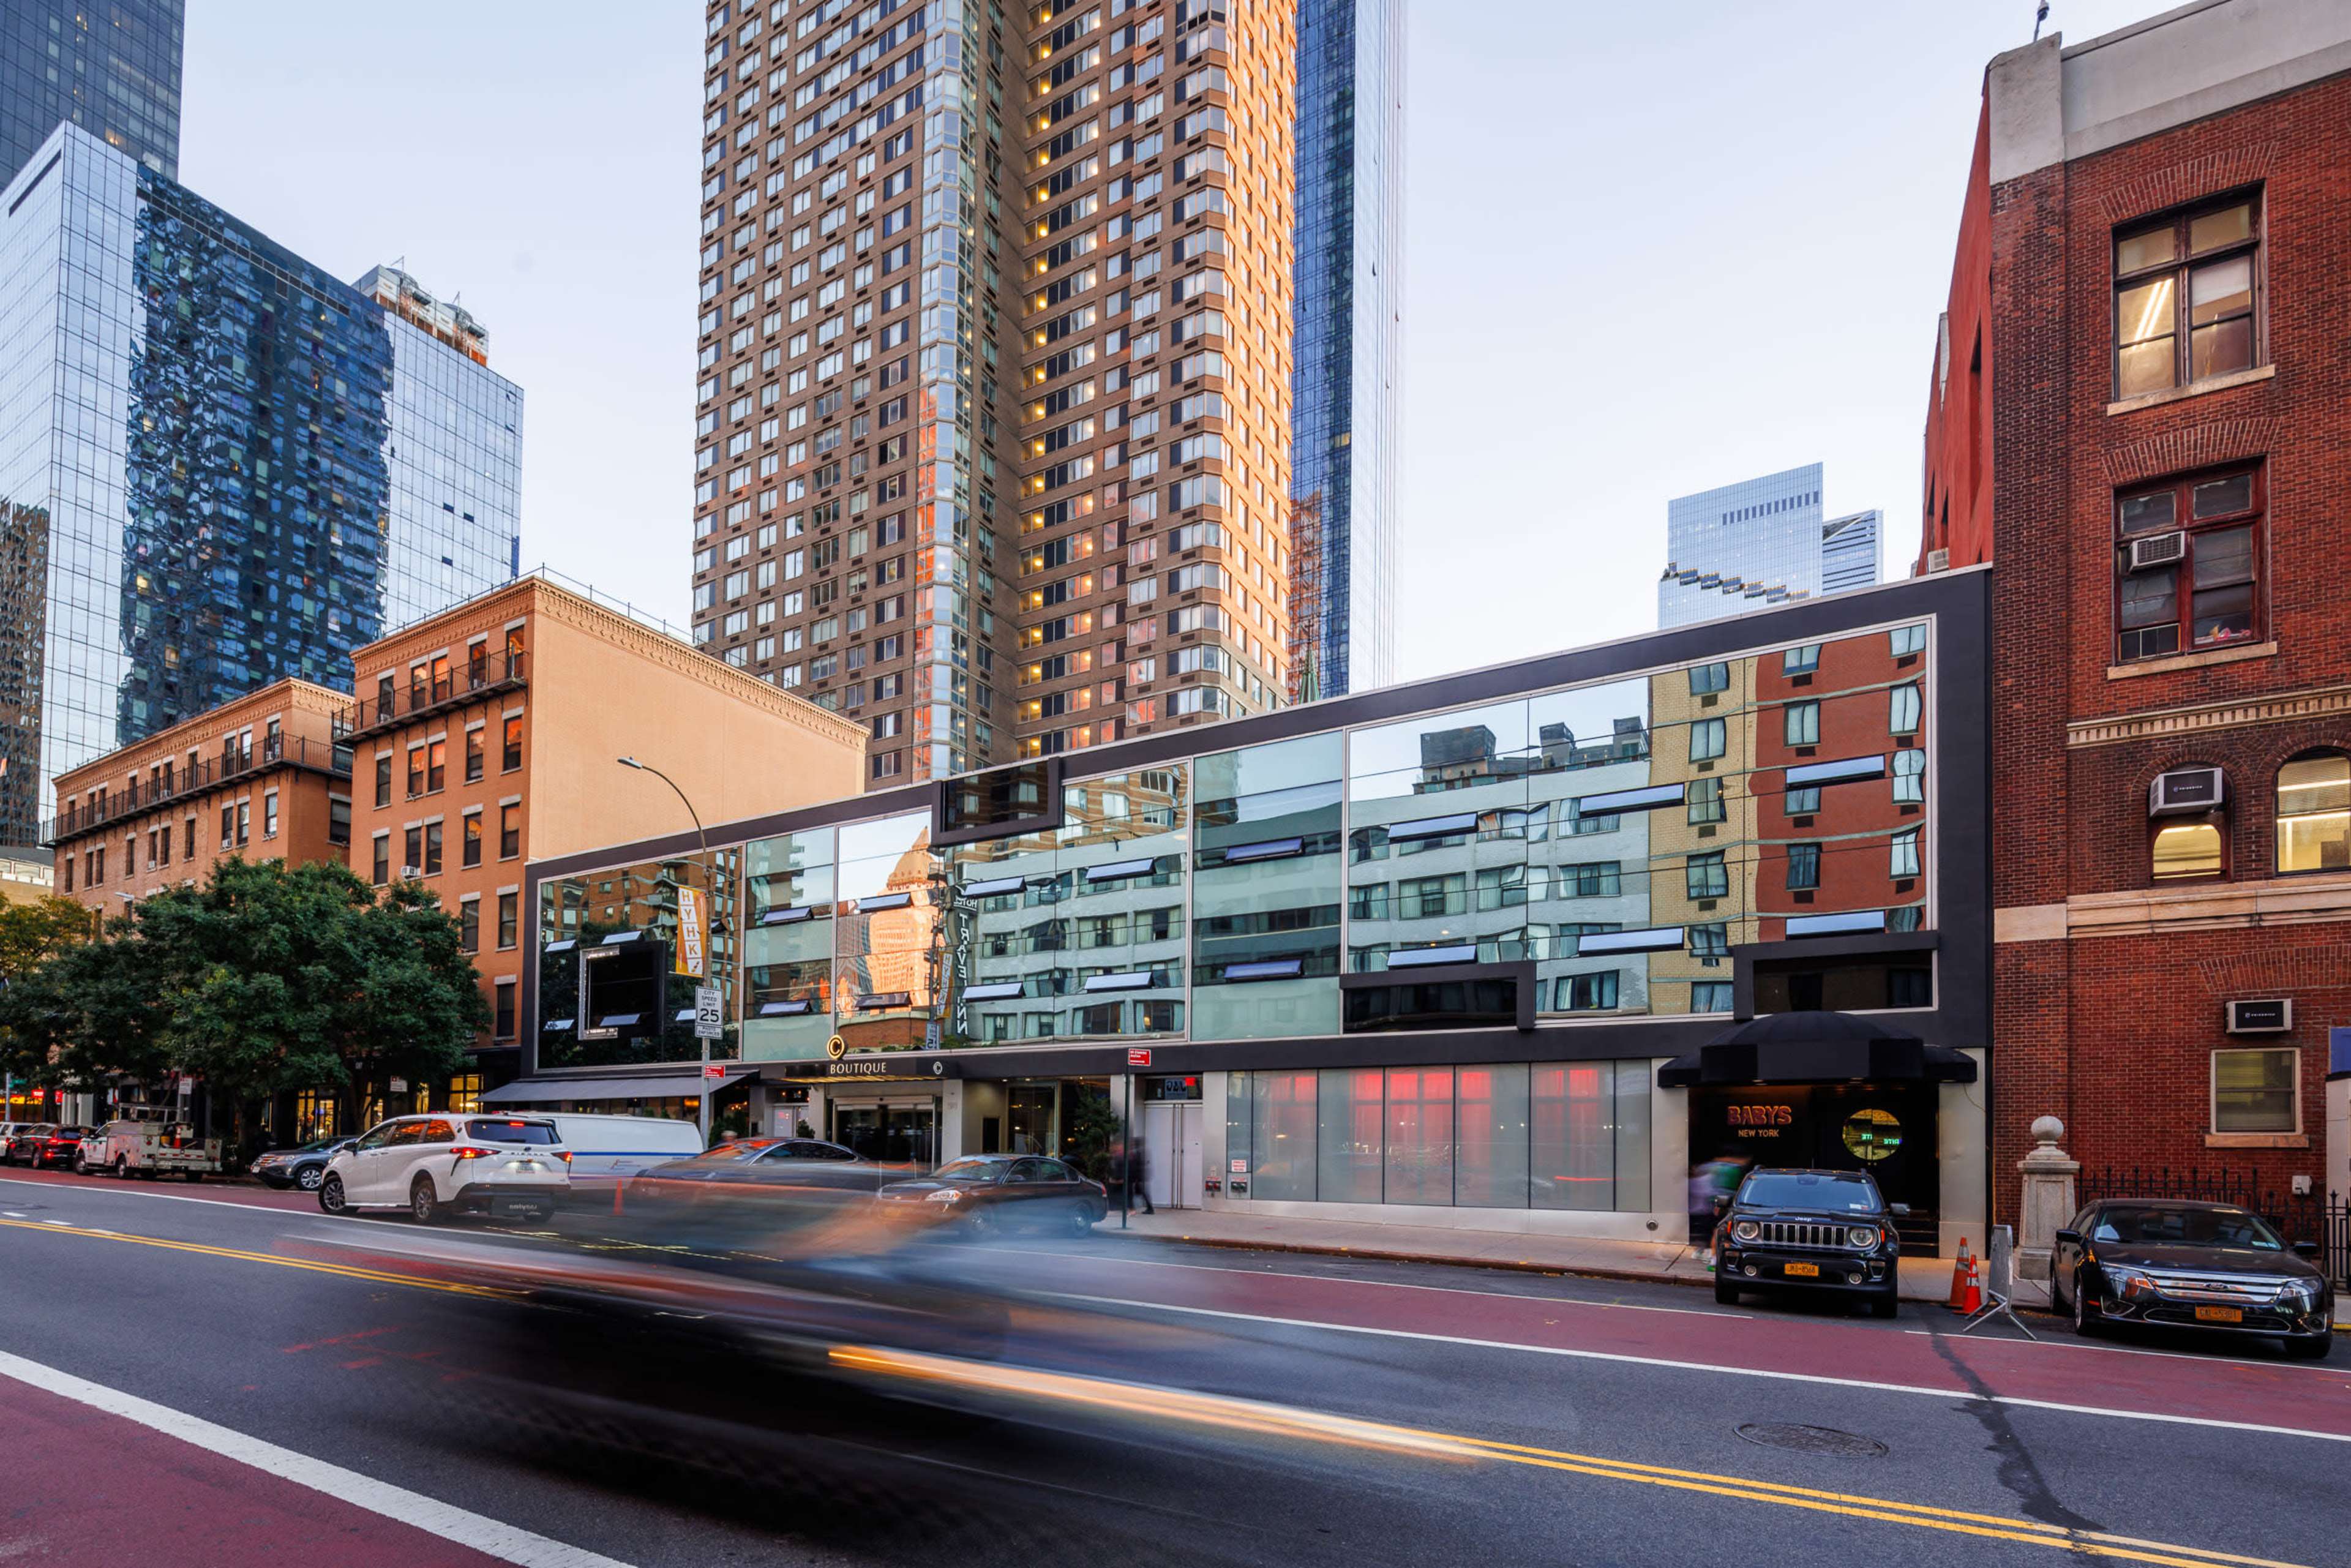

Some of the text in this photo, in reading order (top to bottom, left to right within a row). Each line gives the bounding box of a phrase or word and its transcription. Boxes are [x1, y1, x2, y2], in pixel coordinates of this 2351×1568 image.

[700, 1008, 719, 1022] 25
[830, 1062, 887, 1075] BOUTIQUE
[1727, 1105, 1792, 1125] BABYS
